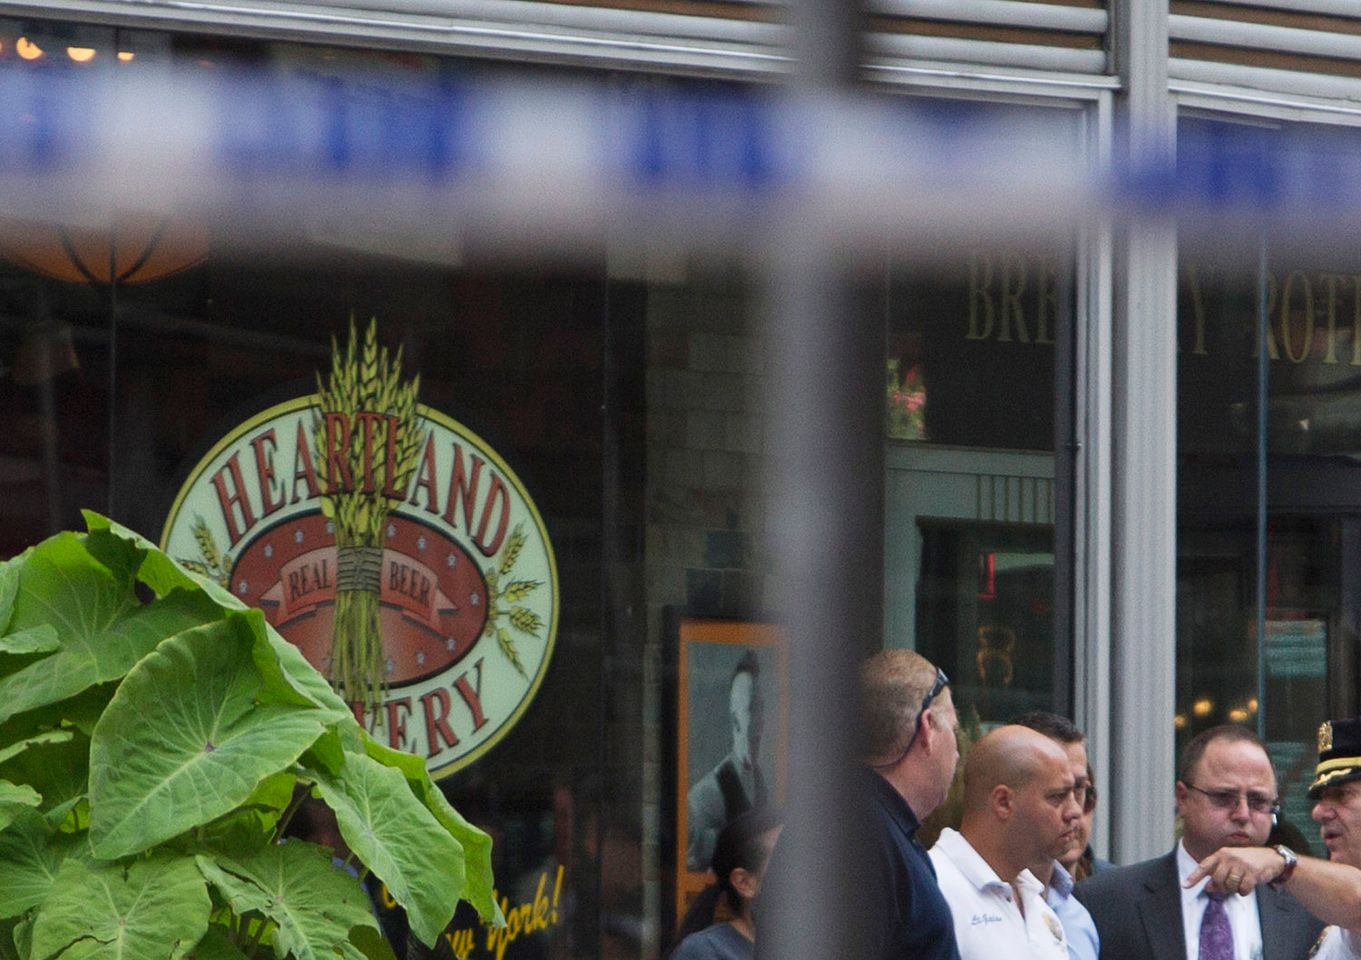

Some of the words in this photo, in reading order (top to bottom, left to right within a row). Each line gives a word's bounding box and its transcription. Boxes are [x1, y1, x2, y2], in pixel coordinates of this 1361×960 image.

[209, 411, 511, 558] HEARTLAND
[289, 558, 331, 597] REAL
[389, 560, 431, 600] BEER
